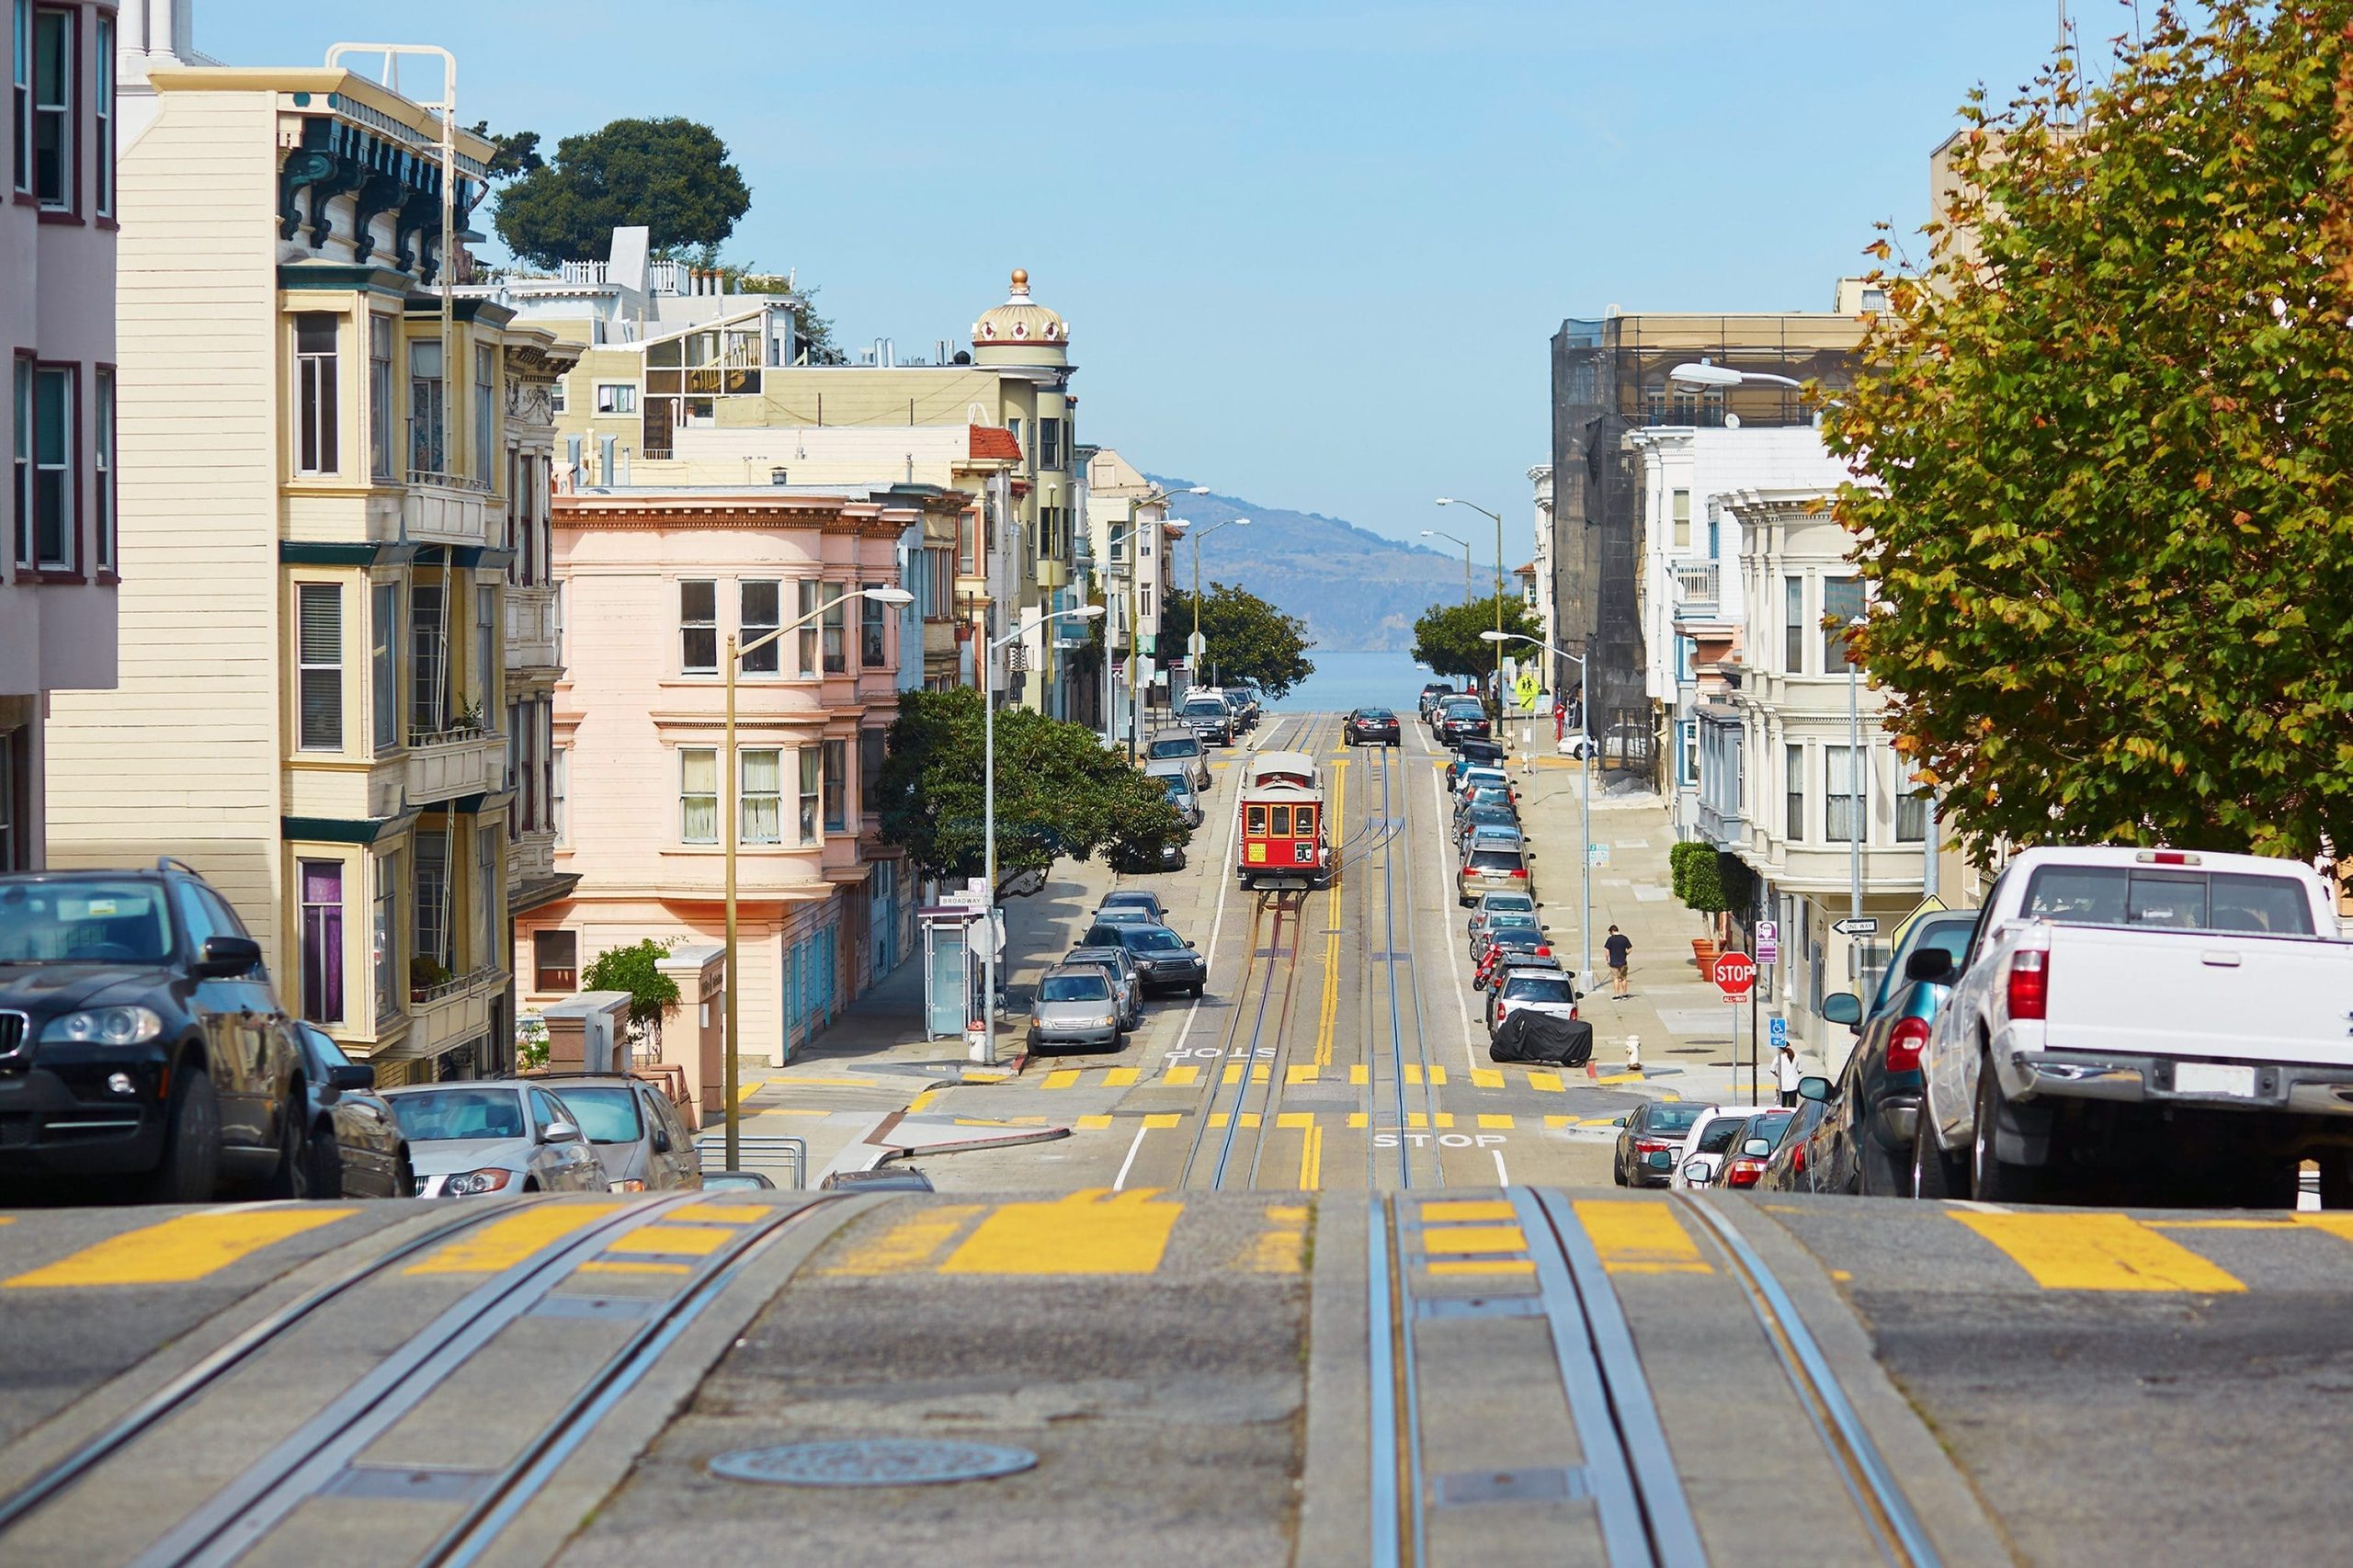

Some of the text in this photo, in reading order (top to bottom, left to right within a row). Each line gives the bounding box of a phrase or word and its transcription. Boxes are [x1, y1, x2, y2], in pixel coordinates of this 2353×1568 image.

[1717, 965, 1753, 983] STOP
[1165, 1047, 1278, 1058] STOP
[1373, 1133, 1507, 1147] STOP
